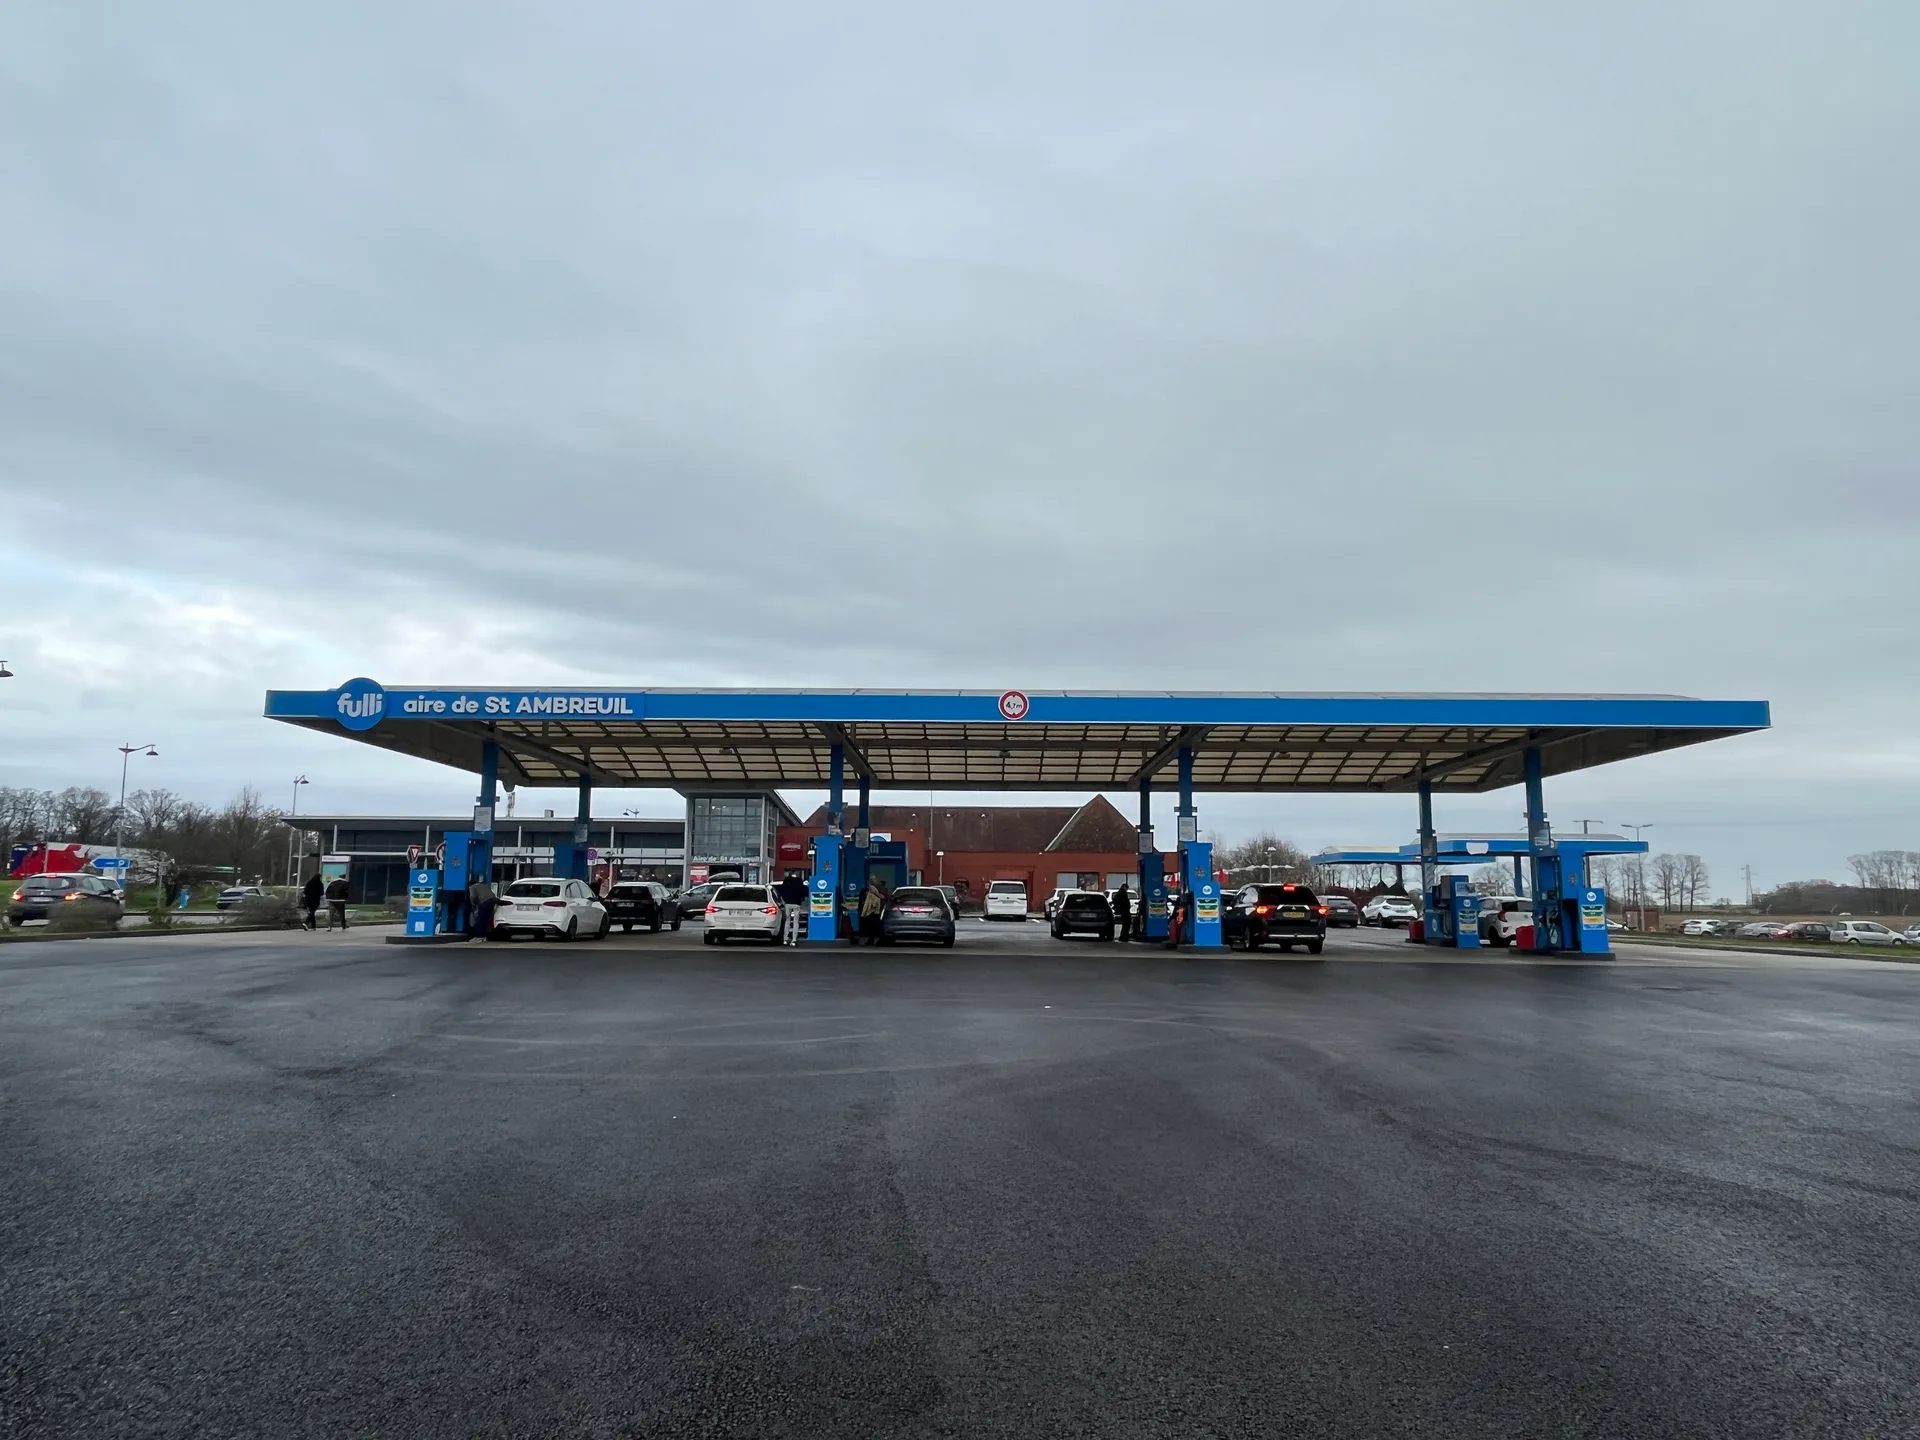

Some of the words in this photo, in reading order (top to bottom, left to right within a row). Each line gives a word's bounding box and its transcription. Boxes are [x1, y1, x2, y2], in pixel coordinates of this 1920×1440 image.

[337, 692, 383, 718] fulli
[403, 694, 446, 714] aire
[451, 694, 478, 714] de
[484, 696, 510, 714] St
[515, 696, 633, 715] AMBREUIL
